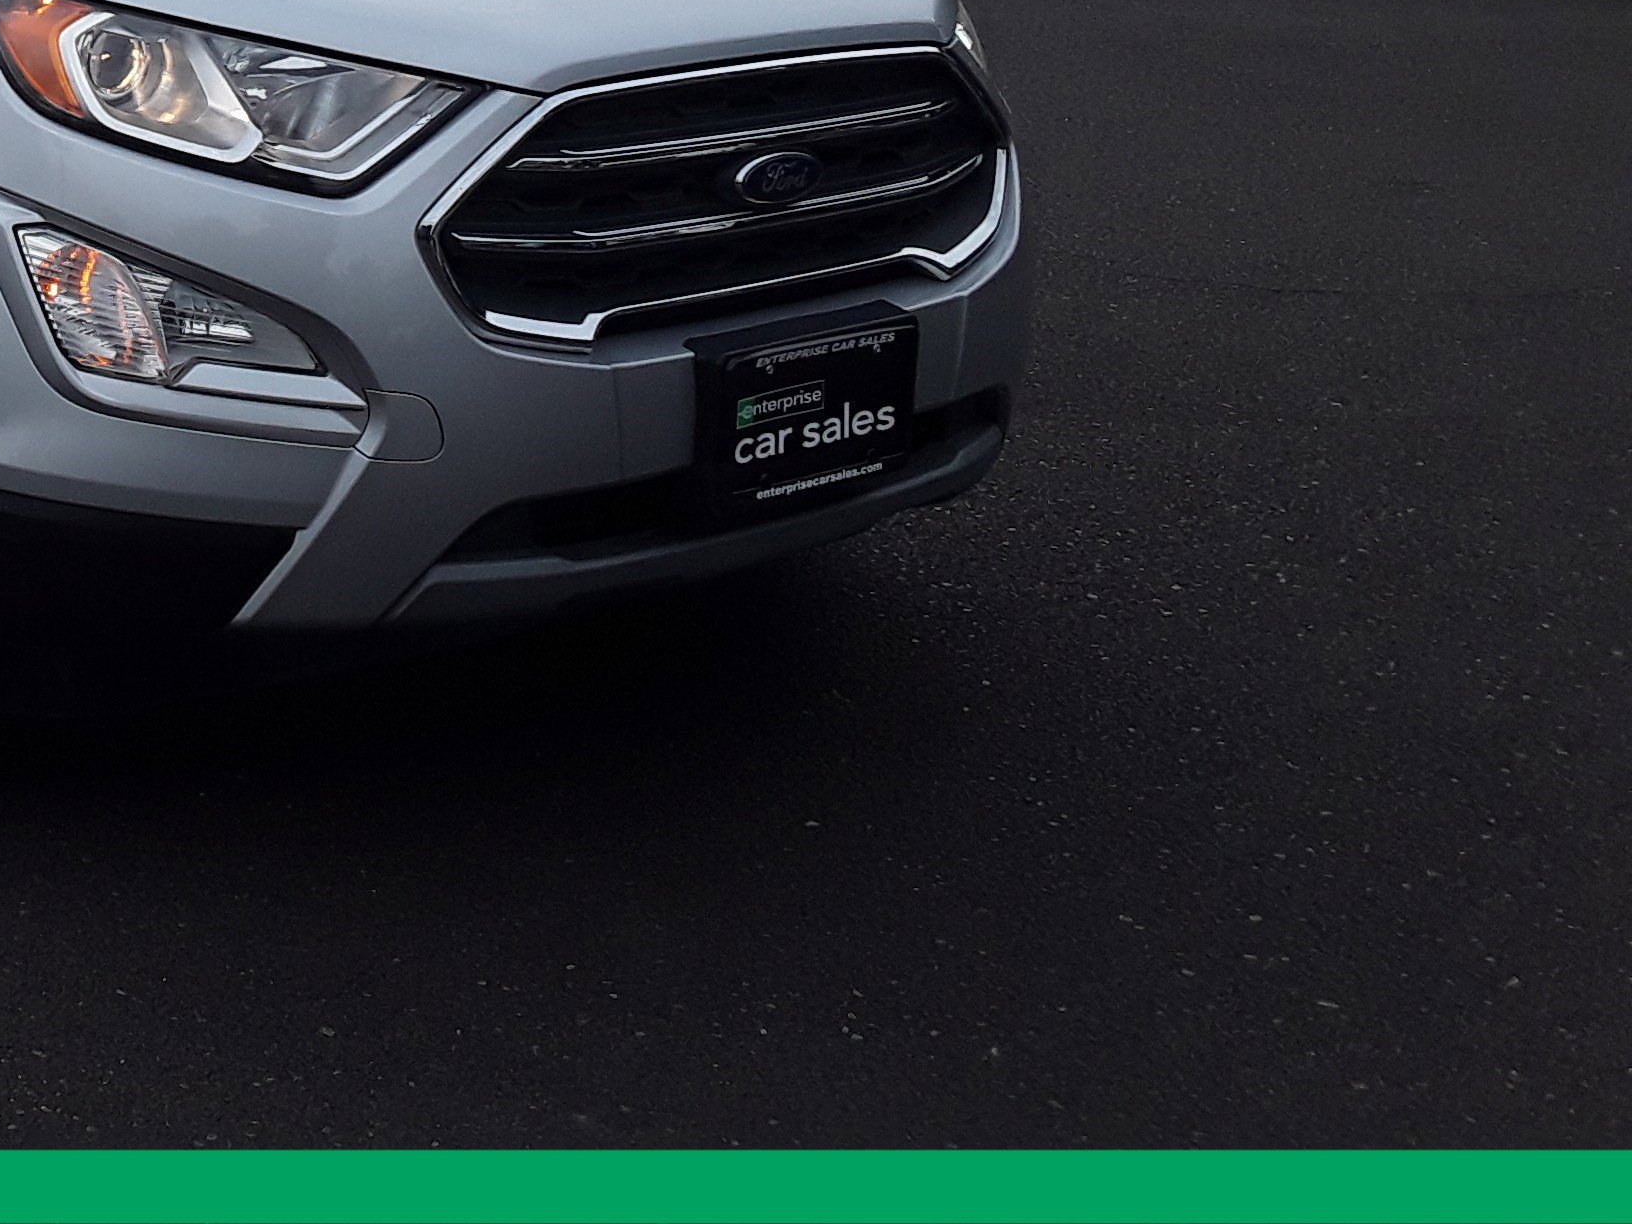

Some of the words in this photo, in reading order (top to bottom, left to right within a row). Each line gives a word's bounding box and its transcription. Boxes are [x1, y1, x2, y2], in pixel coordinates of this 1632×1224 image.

[755, 345, 829, 368] ENTERPRISE
[831, 338, 855, 353] CAR
[857, 331, 896, 348] SALES
[738, 388, 822, 420] enterprise
[734, 426, 793, 464] car
[801, 402, 896, 448] sales
[755, 461, 883, 500] enterprisecarsales.com
